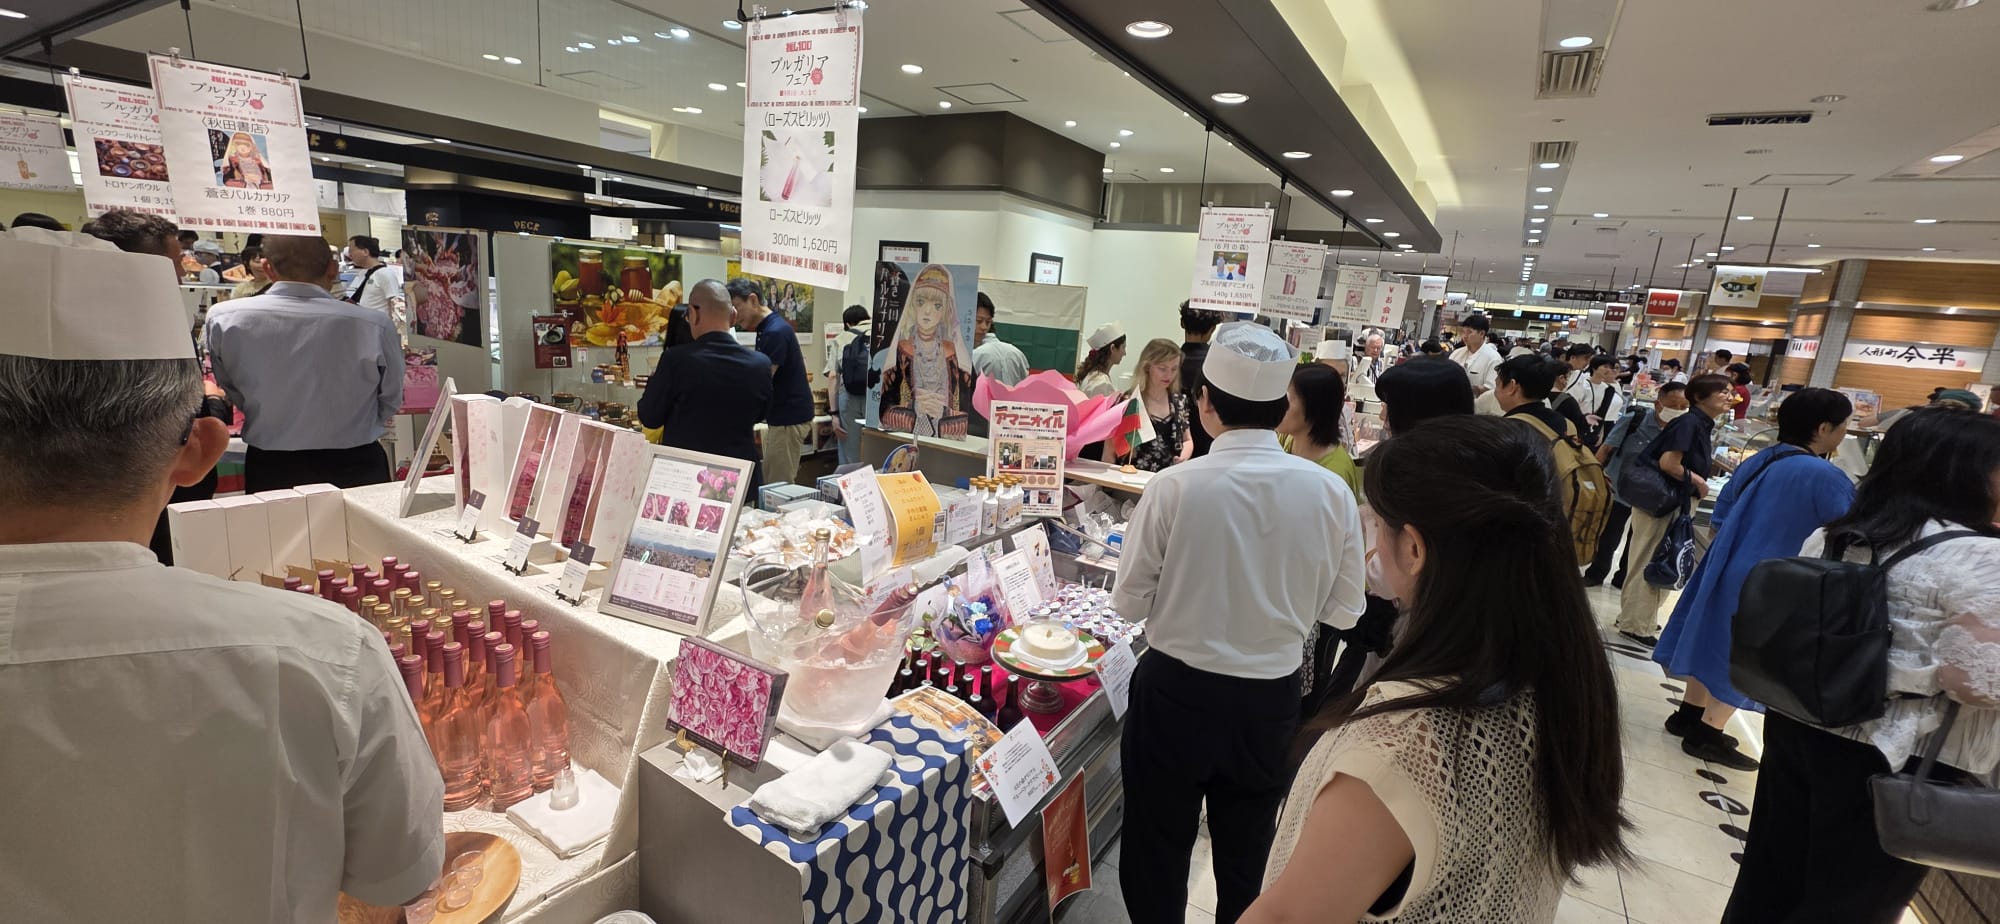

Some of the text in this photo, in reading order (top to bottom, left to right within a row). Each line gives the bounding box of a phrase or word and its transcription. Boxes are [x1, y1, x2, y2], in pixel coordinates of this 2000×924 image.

[770, 54, 829, 74] ブルガリア
[785, 72, 811, 86] フェア
[190, 82, 268, 101] ブルガリア
[214, 96, 249, 108] フェア
[201, 117, 271, 135] 〈秋田書店〉
[204, 187, 290, 203] 蒼きバルカナリア
[237, 205, 295, 218] 1巻 880円
[769, 207, 821, 226] ローズスピリッツ
[513, 220, 541, 232] PECK
[772, 232, 838, 254] 300ml 1,620円
[994, 412, 1065, 429] アマニオイル
